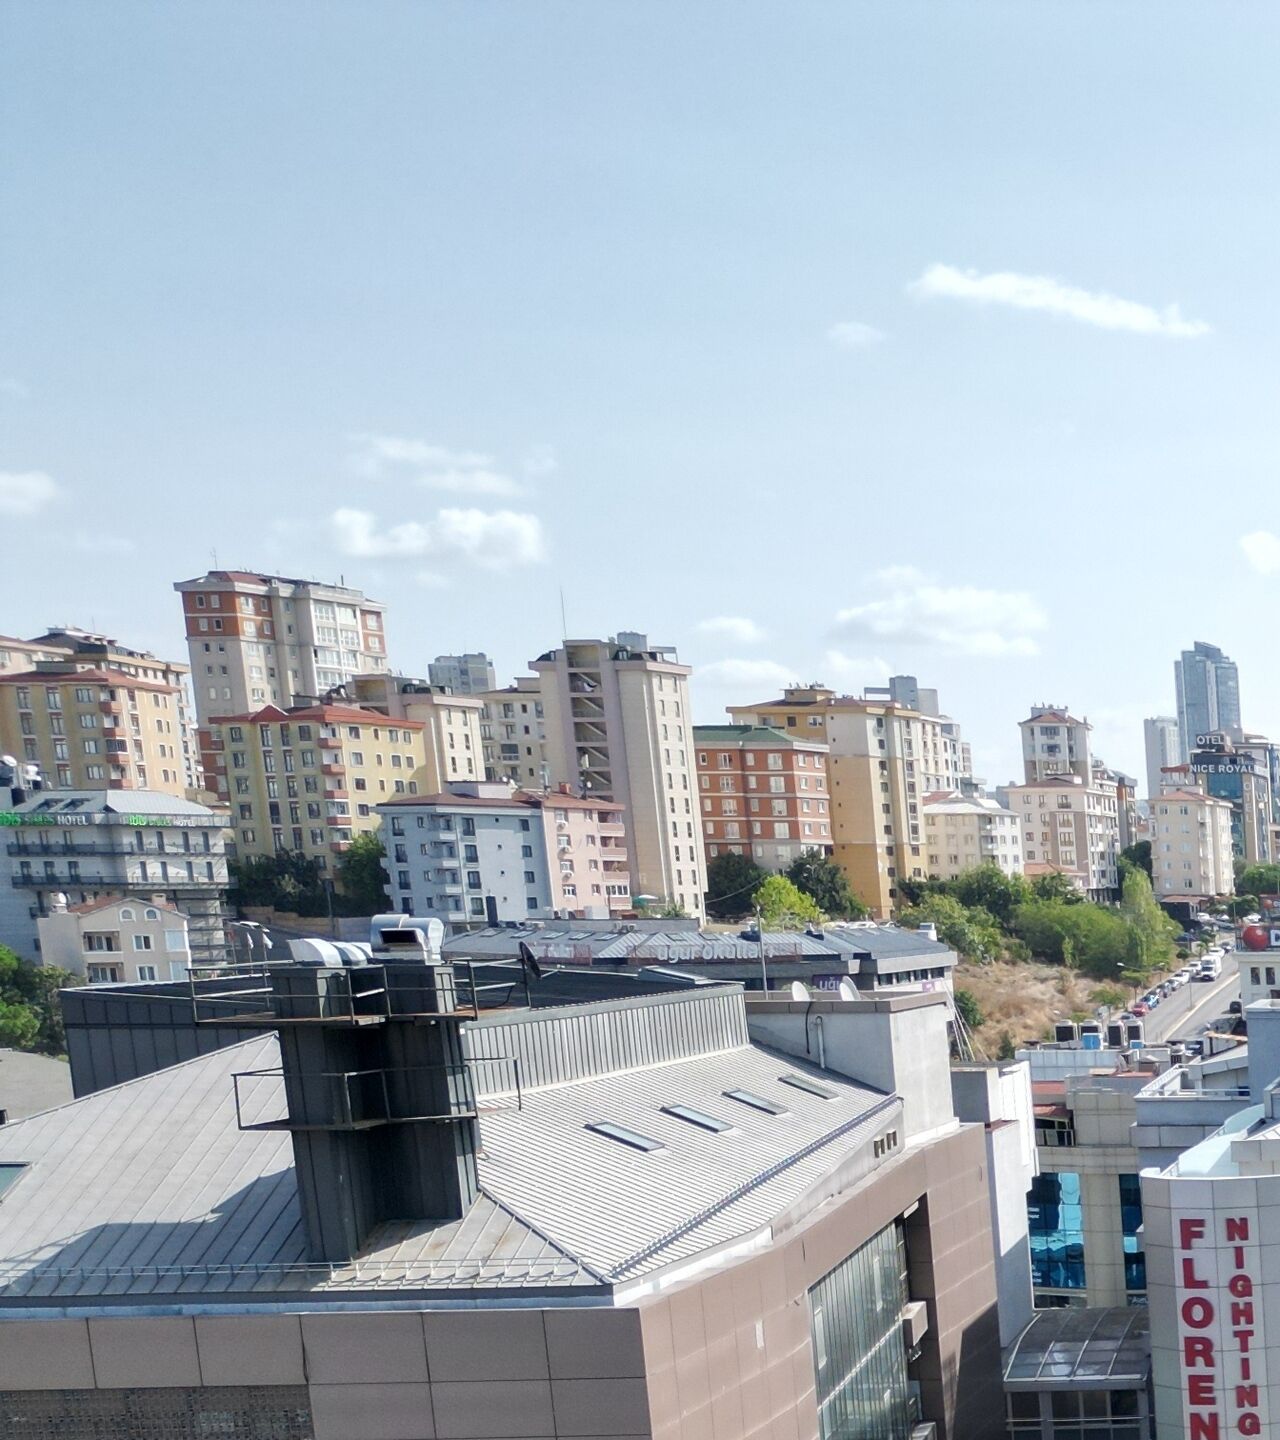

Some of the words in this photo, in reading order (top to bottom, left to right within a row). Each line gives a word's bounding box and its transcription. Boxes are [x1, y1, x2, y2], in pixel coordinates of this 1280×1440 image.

[1197, 735, 1224, 745] OTEL
[1191, 764, 1215, 774] NICE
[1218, 764, 1254, 774] ROYAL
